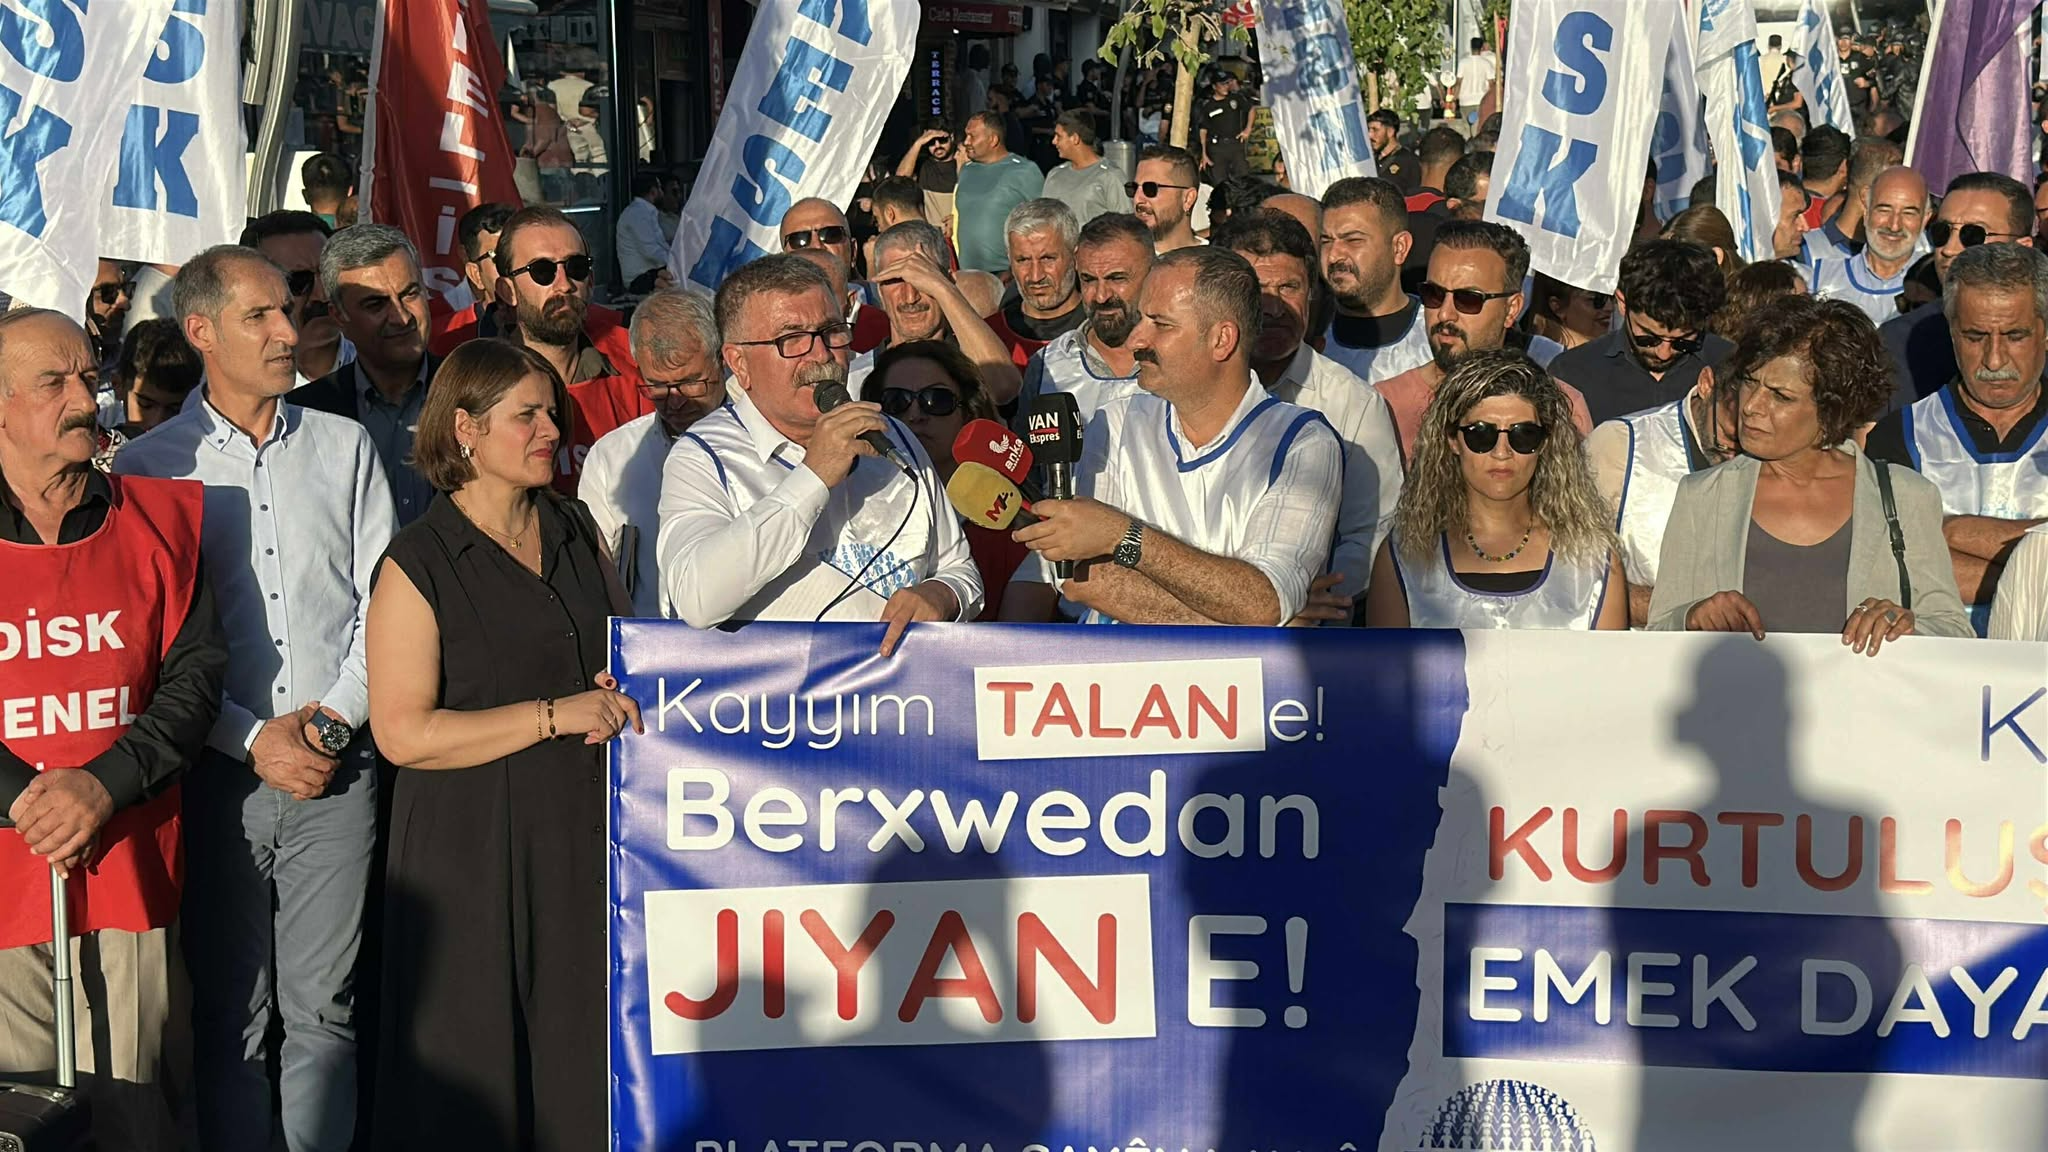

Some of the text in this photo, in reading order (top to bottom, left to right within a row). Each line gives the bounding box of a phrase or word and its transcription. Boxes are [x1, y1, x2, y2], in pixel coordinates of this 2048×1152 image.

[931, 51, 942, 115] TERRACE
[1028, 412, 1059, 431] VAN
[1030, 432, 1060, 445] Ekspres
[3, 686, 137, 739] ENEL
[657, 677, 1325, 749] Kayyım TALAN e!
[665, 767, 1320, 858] Berxwedan
[664, 908, 1309, 1029] JIYAN E!
[1468, 946, 1758, 1031] EMEK
